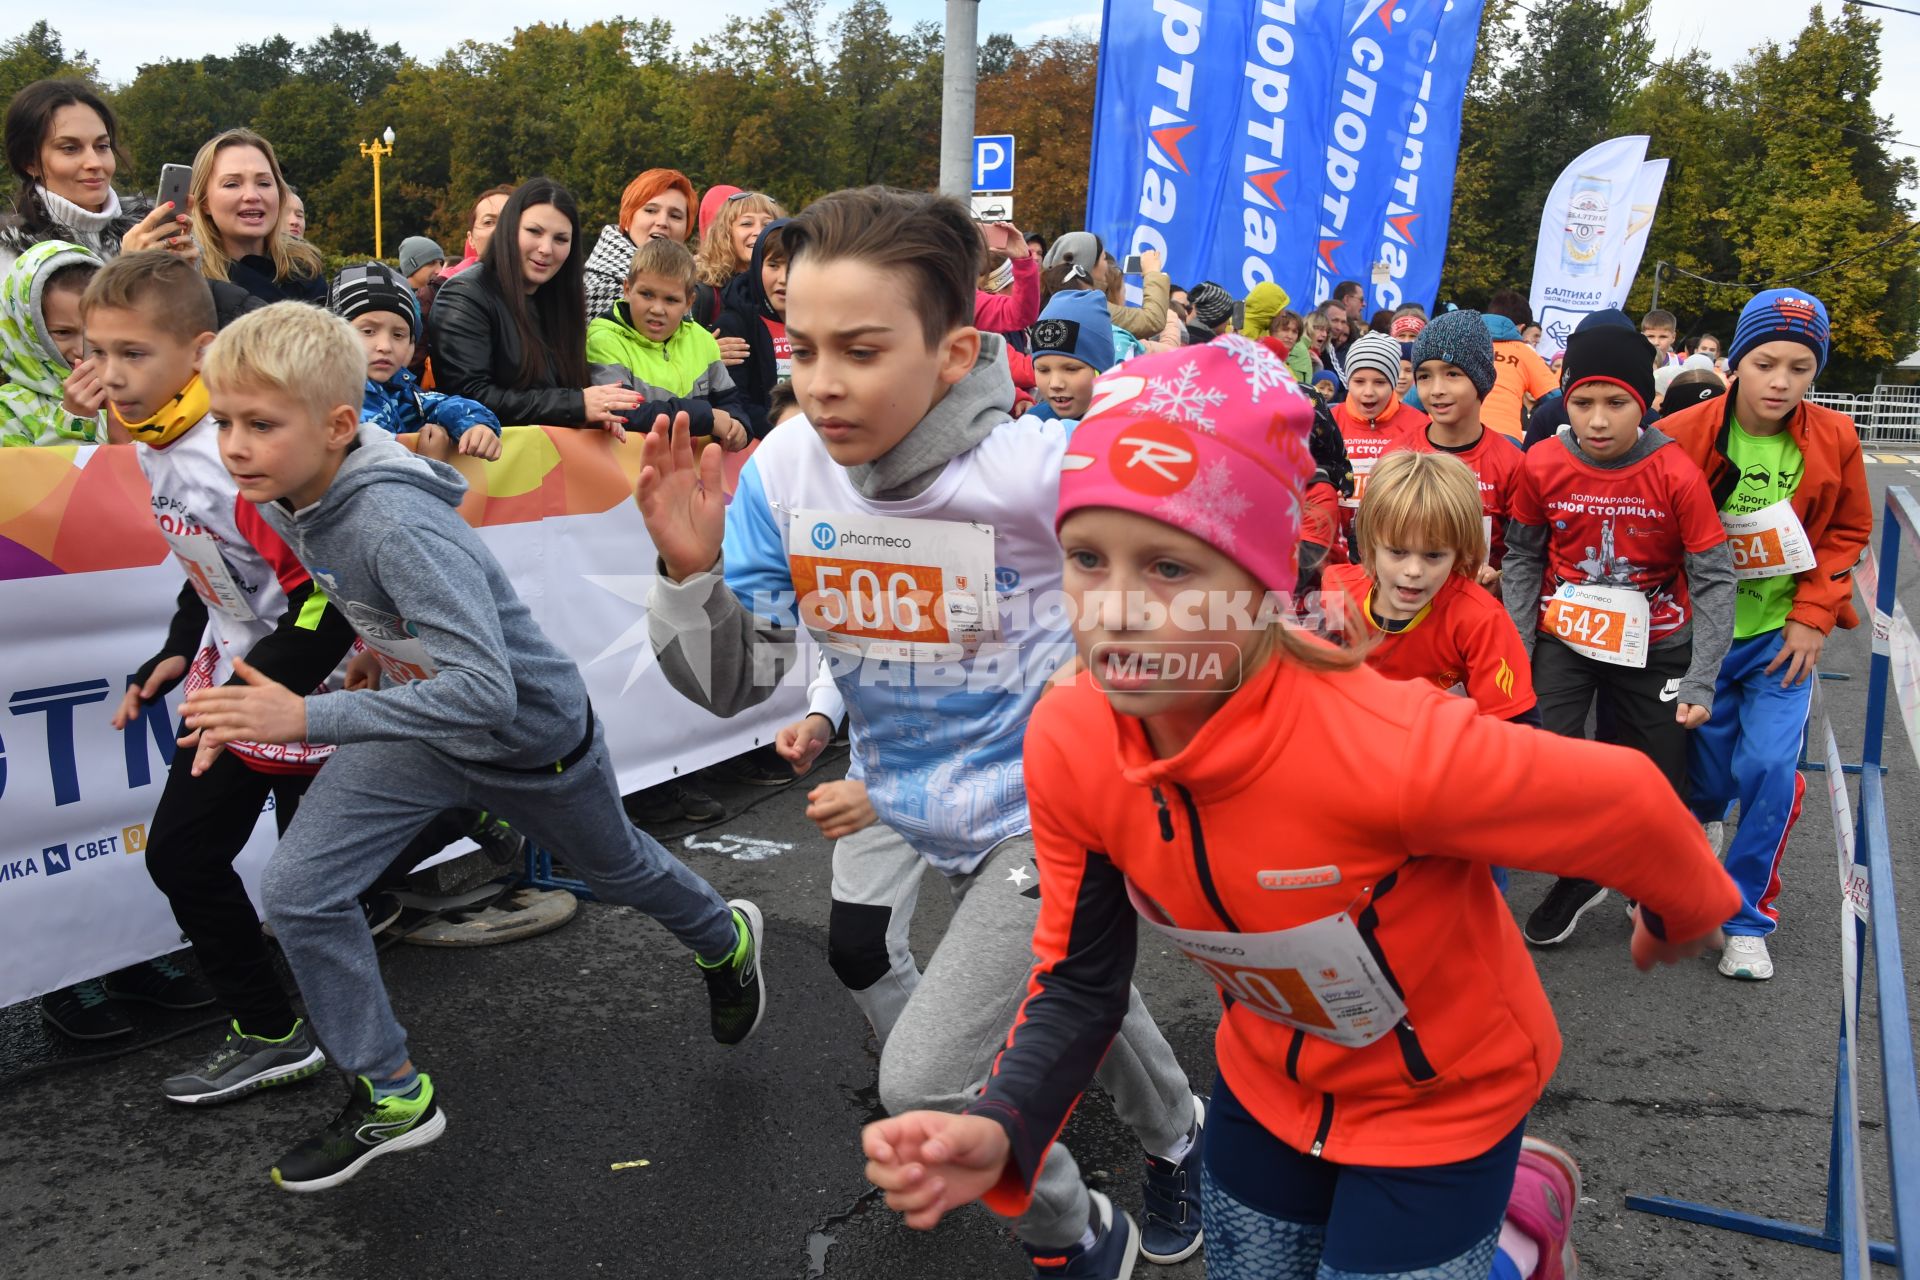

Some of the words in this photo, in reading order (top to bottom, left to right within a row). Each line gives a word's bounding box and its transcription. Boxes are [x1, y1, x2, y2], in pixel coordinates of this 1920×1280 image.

[977, 142, 1005, 186] P
[1544, 287, 1593, 299] БАЛТИКА
[1118, 437, 1193, 482] R
[1570, 493, 1645, 505] ПОЛУМАРАФОН
[1548, 501, 1584, 513] «МОЯ
[1587, 505, 1665, 519] СТОЛИЦА»
[840, 531, 911, 549] pharmeco
[815, 565, 921, 633] 506
[1575, 590, 1612, 604] pharmeco
[1748, 588, 1763, 602] run
[1556, 604, 1611, 646] 542
[74, 836, 118, 861] СВЕТ
